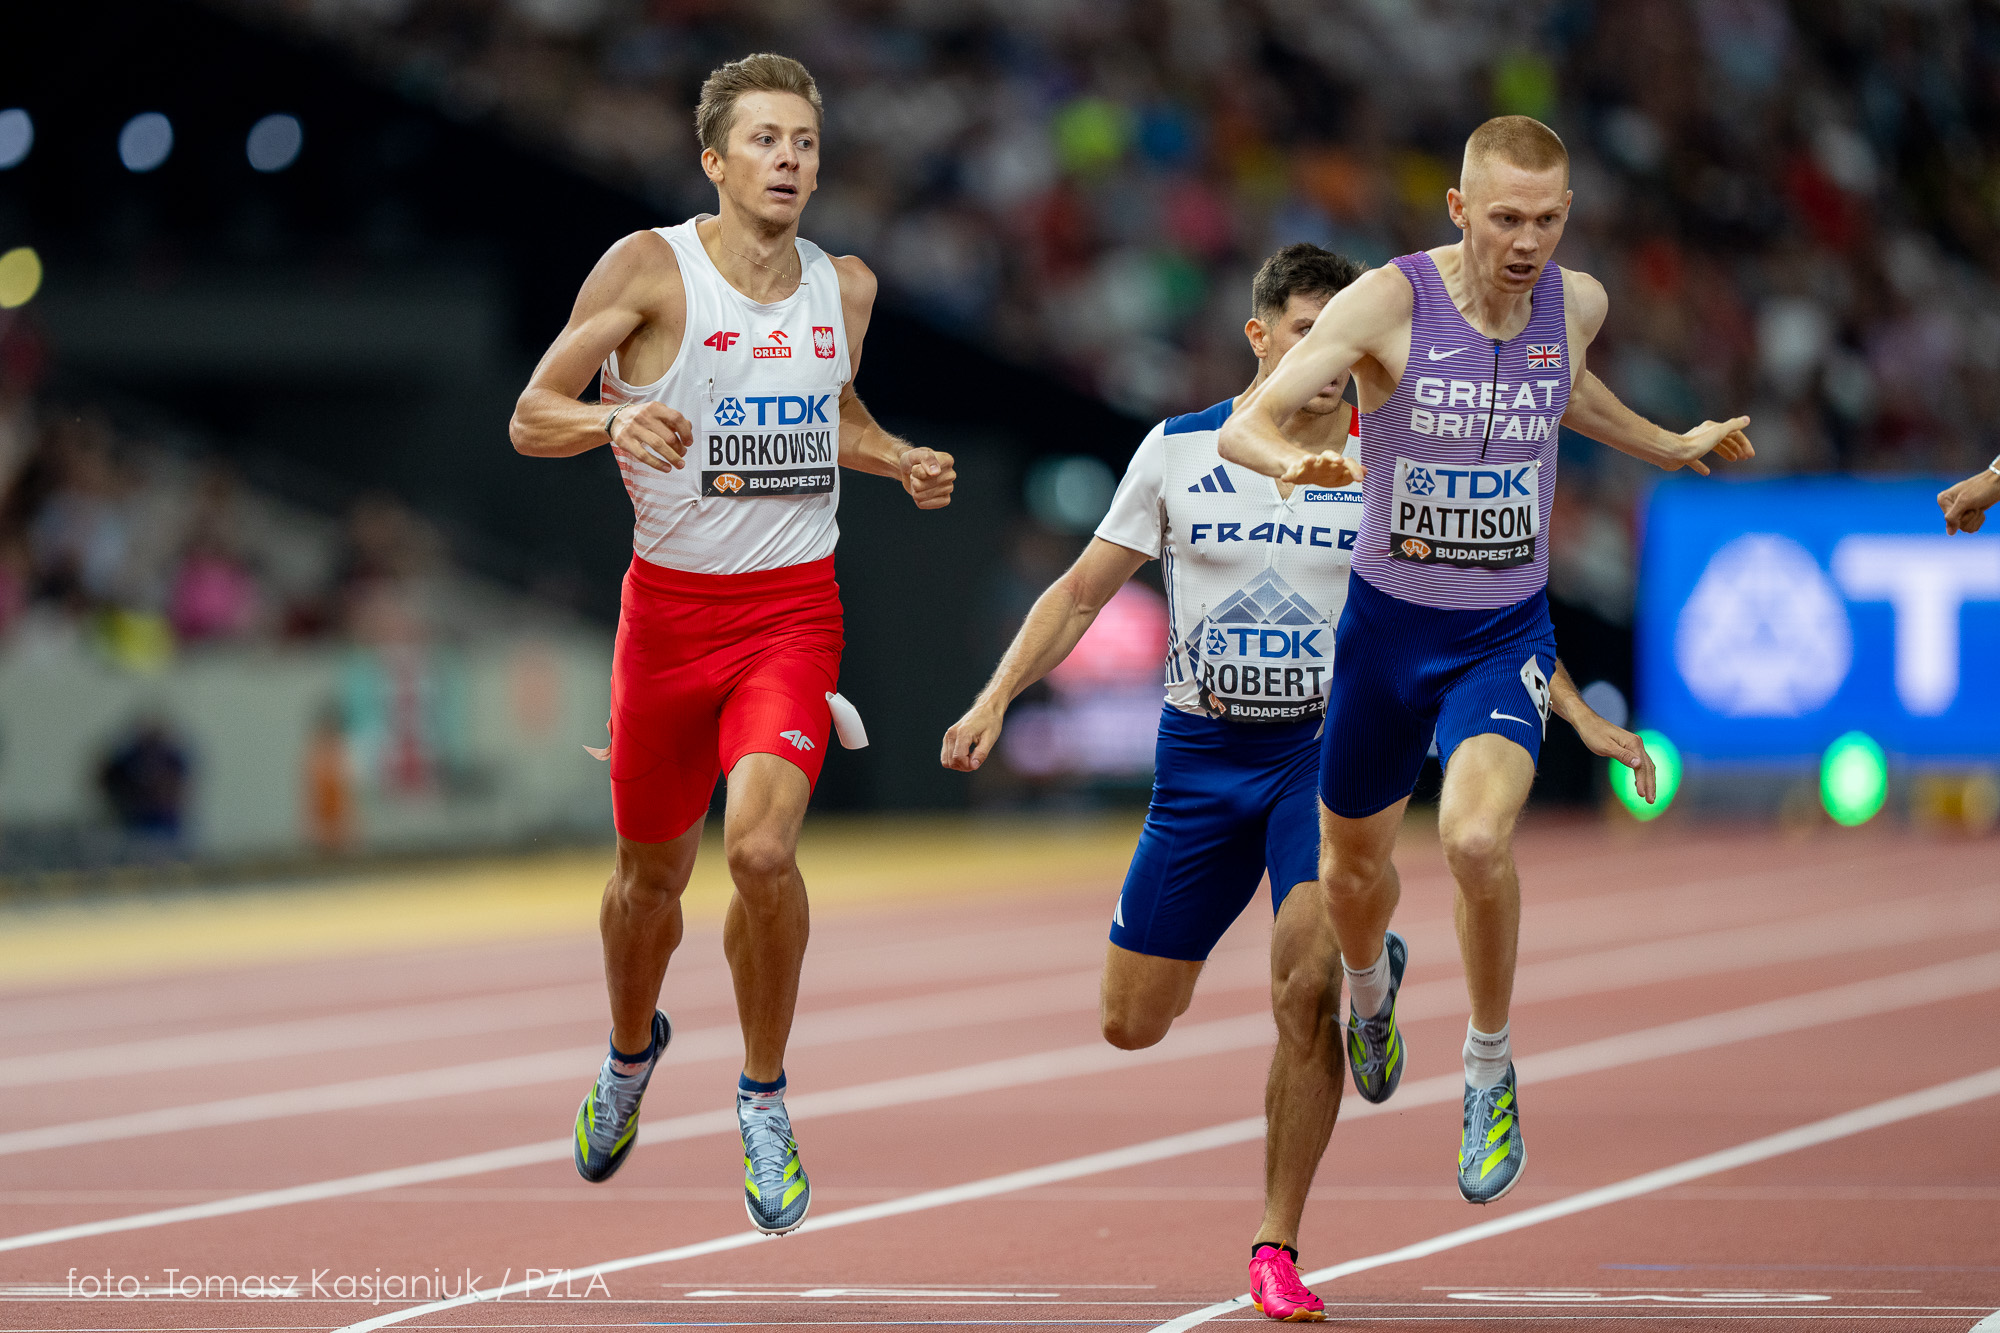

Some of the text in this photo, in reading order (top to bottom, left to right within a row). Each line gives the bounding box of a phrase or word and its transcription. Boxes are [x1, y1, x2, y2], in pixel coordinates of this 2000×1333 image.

[704, 331, 740, 351] 4F
[754, 349, 789, 357] ORLEN
[1414, 377, 1559, 410] GREAT
[745, 395, 831, 425] TDK
[1410, 408, 1556, 441] BRITAIN
[709, 431, 832, 465] BORKOWSKI
[1307, 492, 1333, 502] Crédit
[1436, 467, 1531, 498] TDK
[1400, 501, 1532, 539] PATTISON
[1227, 629, 1323, 658] TDK
[1203, 662, 1325, 697] ROBERT
